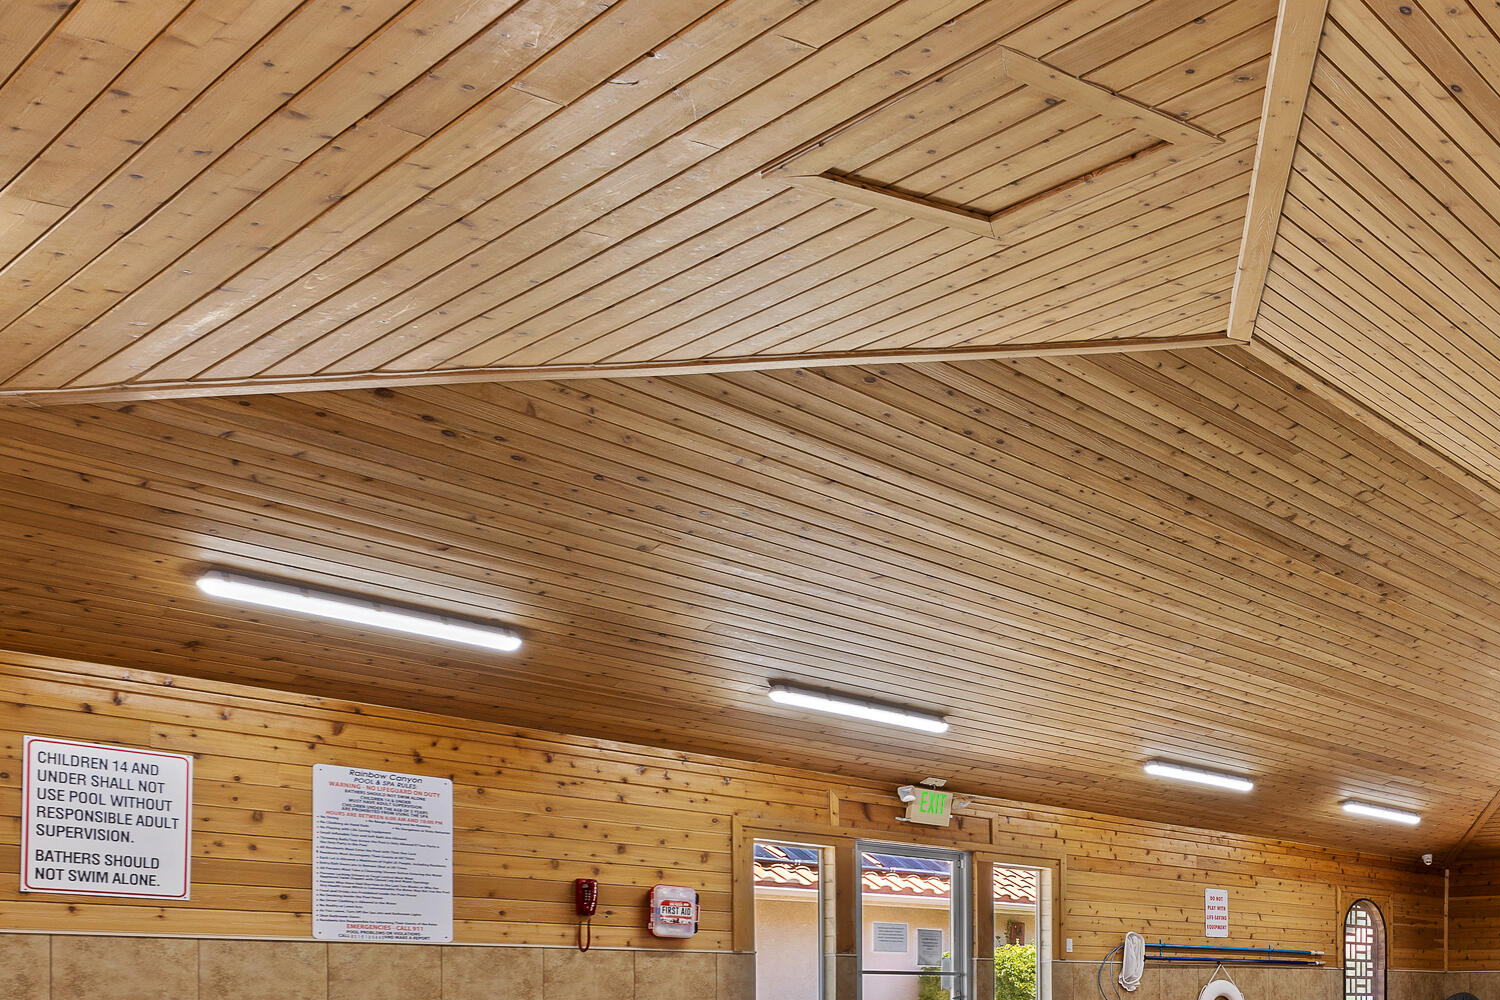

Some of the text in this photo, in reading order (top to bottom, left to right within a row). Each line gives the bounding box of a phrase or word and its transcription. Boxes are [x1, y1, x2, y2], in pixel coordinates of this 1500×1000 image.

[38, 751, 159, 776] CHILDREN 14 AND
[37, 769, 165, 794] UNDER SHALL NOT
[349, 769, 422, 784] Rainbow Canyon
[329, 782, 360, 790] WARNING
[377, 786, 412, 794] LIFEGUARD
[37, 787, 172, 811] USE POOL WITHOUT
[920, 792, 947, 815] EXIT
[36, 806, 179, 829] RESPONSIBLE ADULT
[36, 824, 134, 844] SUPERVISION.
[35, 849, 160, 869] BATHERS SHOULD
[35, 868, 160, 886] NOT SWIM ALONE.
[662, 906, 679, 914] FIRST
